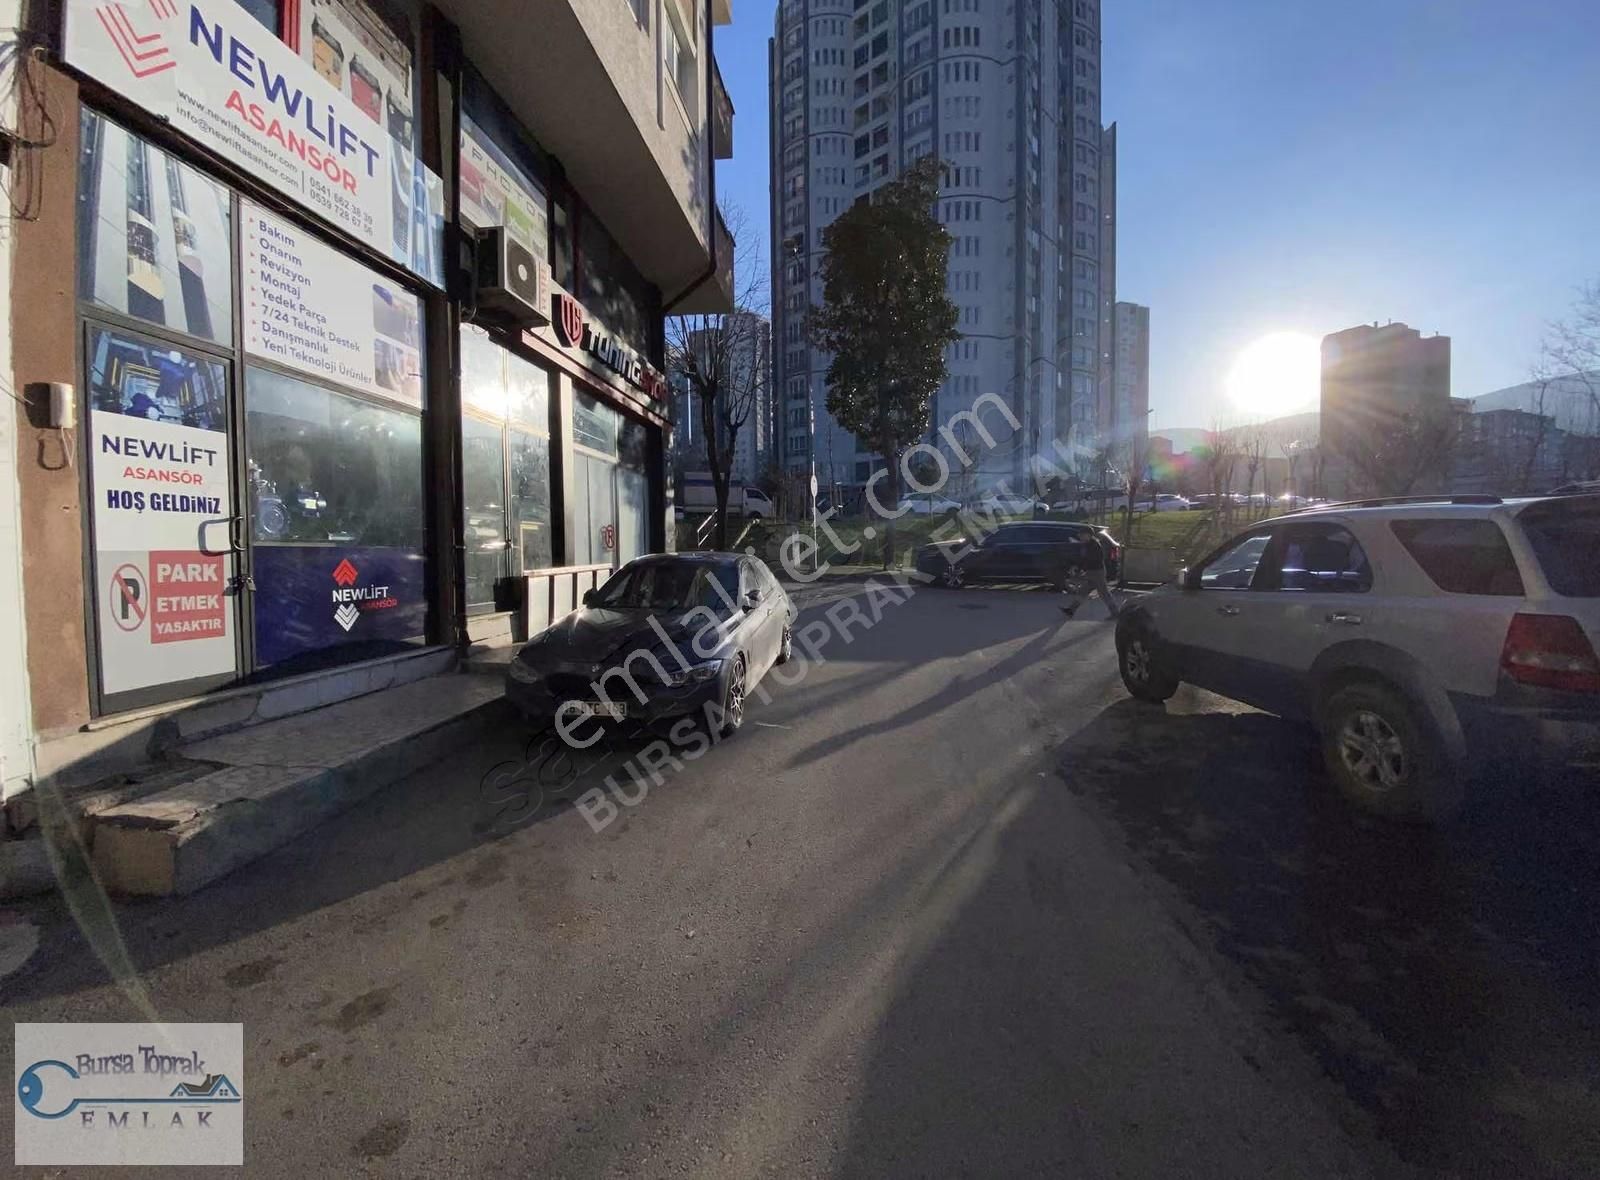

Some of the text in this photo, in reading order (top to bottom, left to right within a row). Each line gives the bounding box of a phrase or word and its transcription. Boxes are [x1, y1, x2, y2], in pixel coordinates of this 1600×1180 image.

[225, 89, 358, 197] ASANSÖR
[309, 176, 331, 198] 0541
[258, 220, 296, 248] Bakım
[259, 237, 303, 267] Onarım
[260, 253, 312, 287] Revizyon
[260, 270, 301, 300] Montaj
[260, 287, 327, 324] Yedek Parça
[261, 304, 361, 353] 7/24 Teknik Destek
[261, 320, 330, 355] Danışmanlık
[262, 337, 287, 355] Yeni
[289, 347, 337, 372] Teknoloji
[123, 465, 203, 486] ASANSÖR
[107, 489, 146, 514] HOŞ
[156, 563, 218, 583] PARK
[156, 594, 219, 613] ETMEK
[155, 618, 222, 635] YASAKTIR
